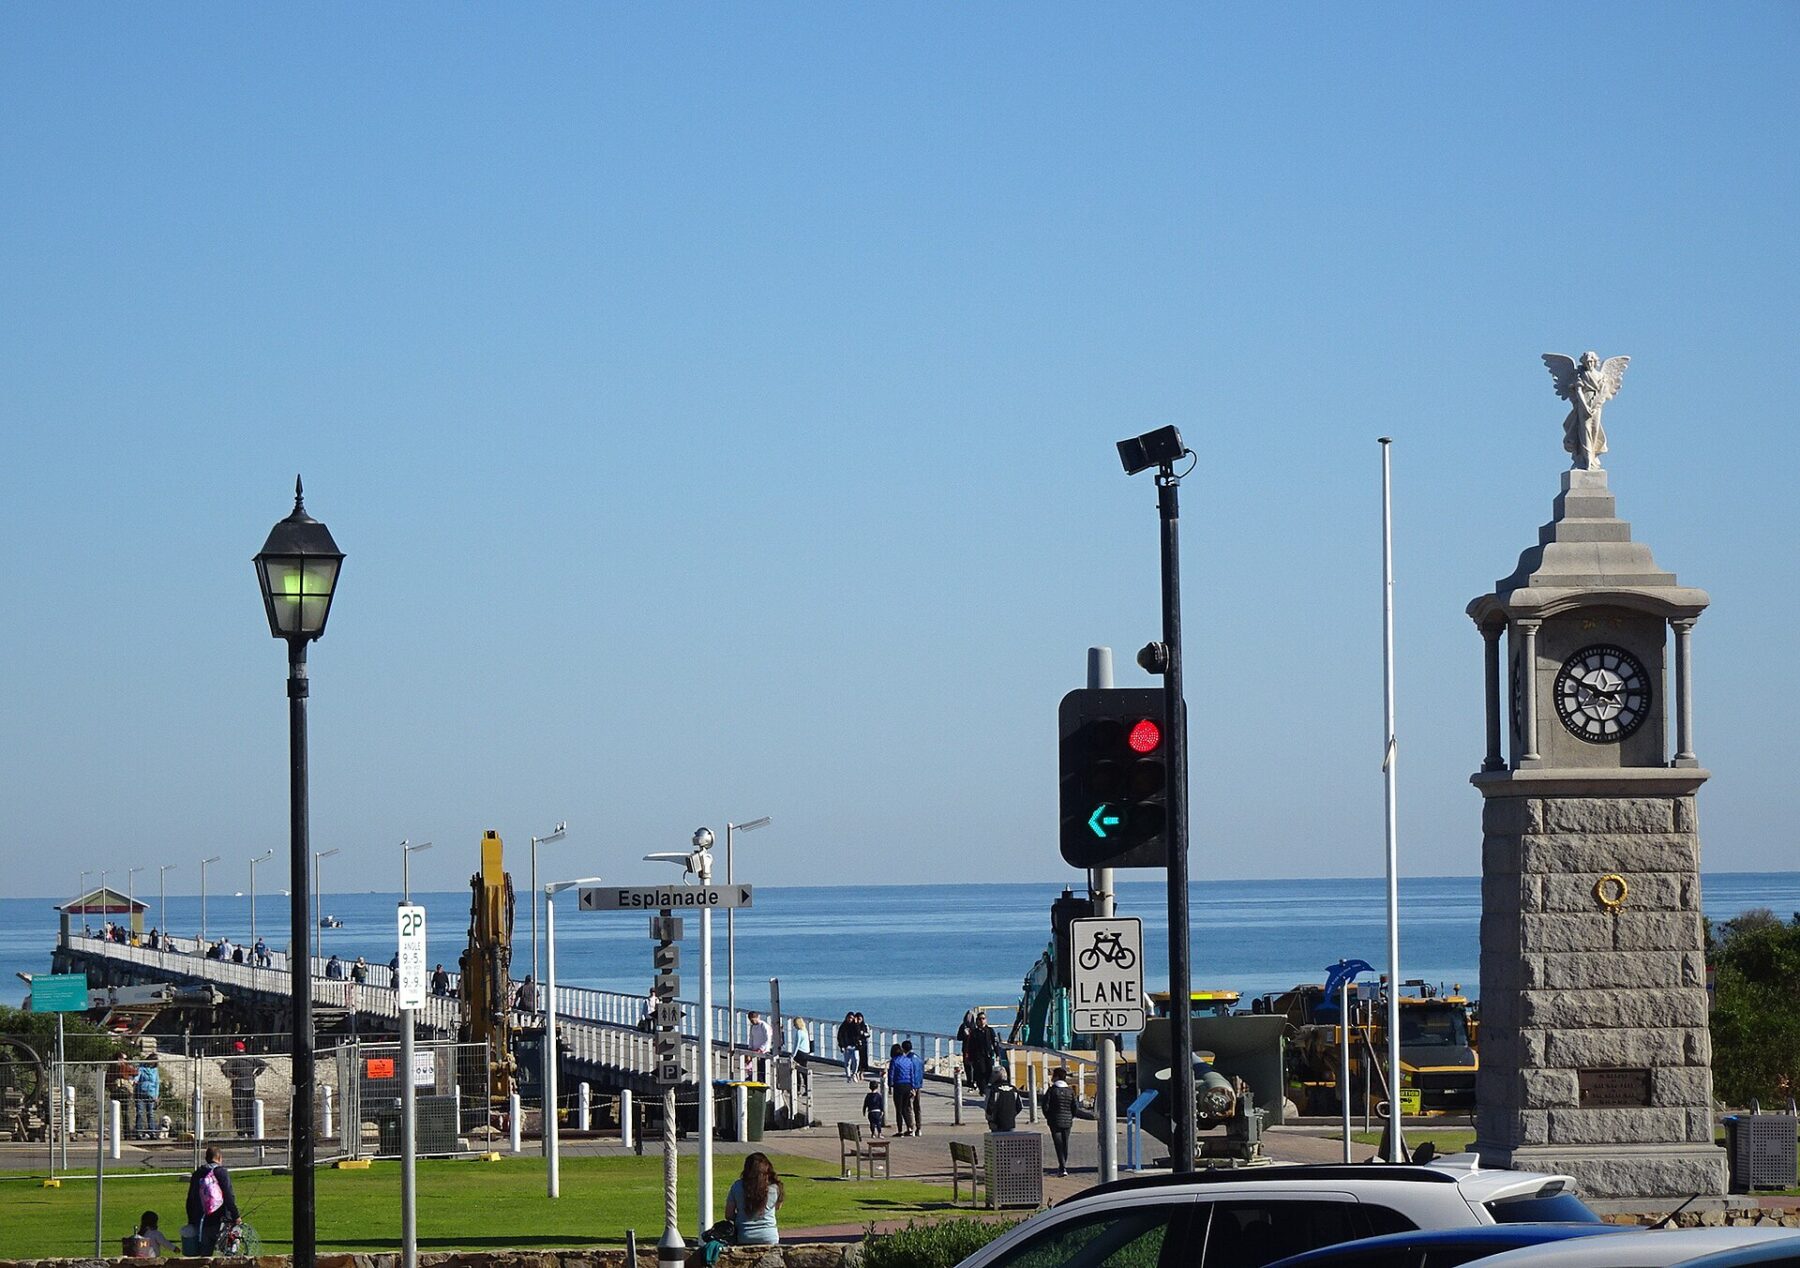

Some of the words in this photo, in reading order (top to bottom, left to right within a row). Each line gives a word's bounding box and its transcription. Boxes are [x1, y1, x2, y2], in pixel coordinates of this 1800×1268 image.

[618, 889, 718, 909] Esplanade
[402, 914, 422, 936] 2P
[1080, 981, 1136, 1003] LANE
[1090, 1013, 1127, 1027] END
[666, 1067, 675, 1078] P
